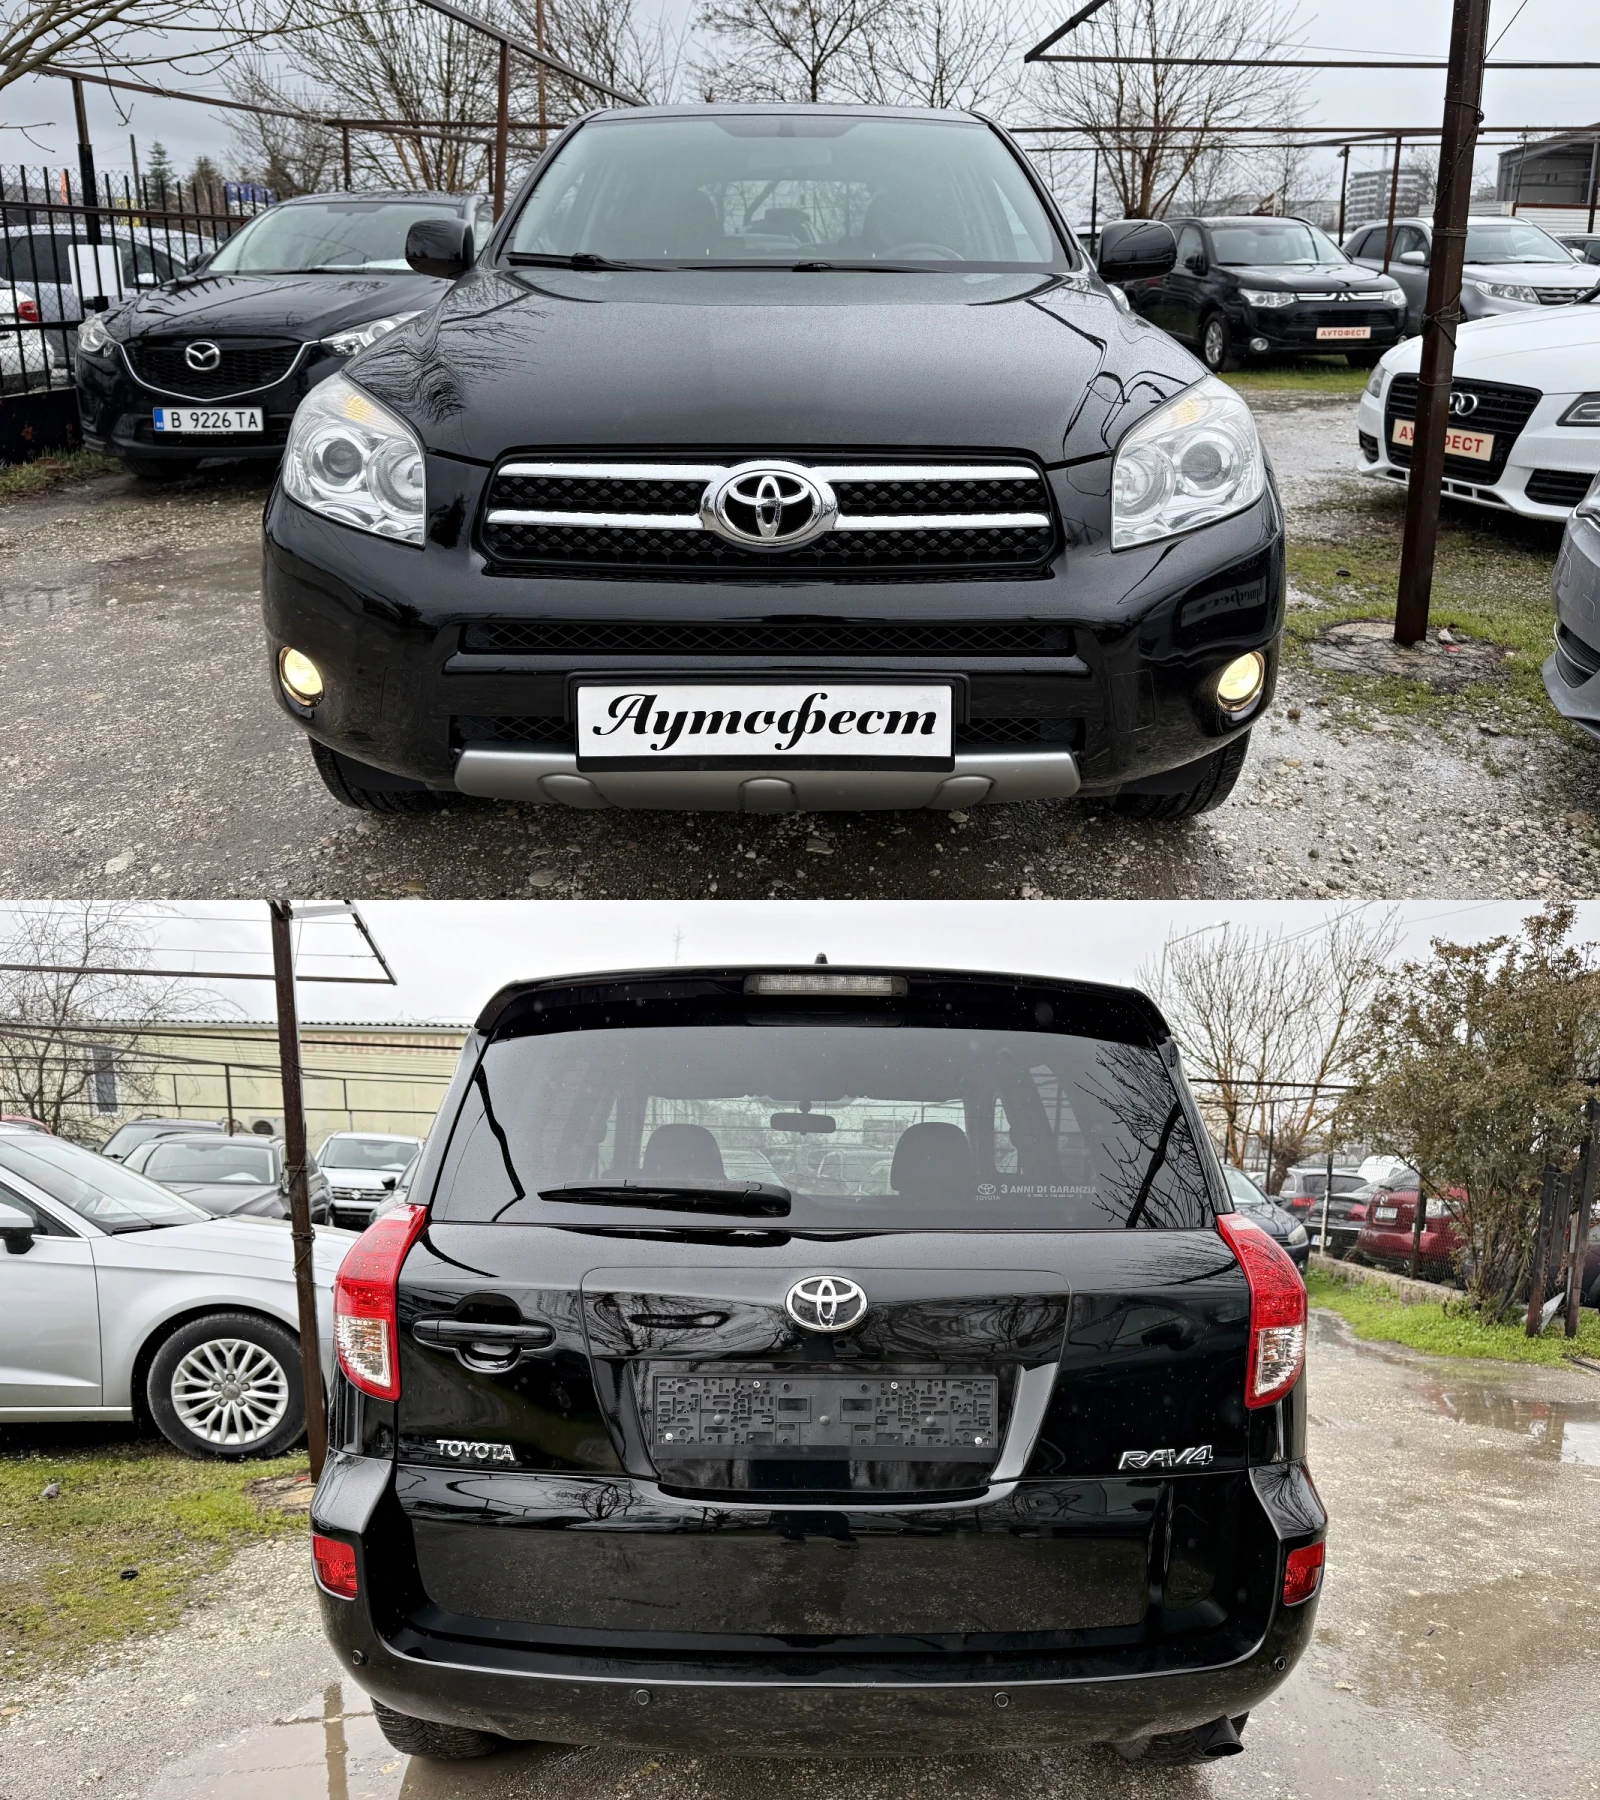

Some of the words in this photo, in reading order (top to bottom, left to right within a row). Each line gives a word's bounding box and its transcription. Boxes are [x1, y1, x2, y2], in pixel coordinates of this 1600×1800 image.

[1321, 329, 1367, 337] АУТОФЕСТ
[171, 411, 182, 429] B
[190, 411, 232, 429] 9226
[235, 411, 259, 429] TA
[592, 692, 938, 752] Аутофест
[301, 1032, 458, 1056] ВТОМОБИЛИ
[1001, 1184, 1008, 1194] 3
[1010, 1185, 1034, 1194] ANNI
[1037, 1185, 1047, 1194] DI
[1050, 1185, 1098, 1194] GARANZIA
[436, 1439, 516, 1461] TOYOTA
[1117, 1445, 1214, 1469] RAV4
